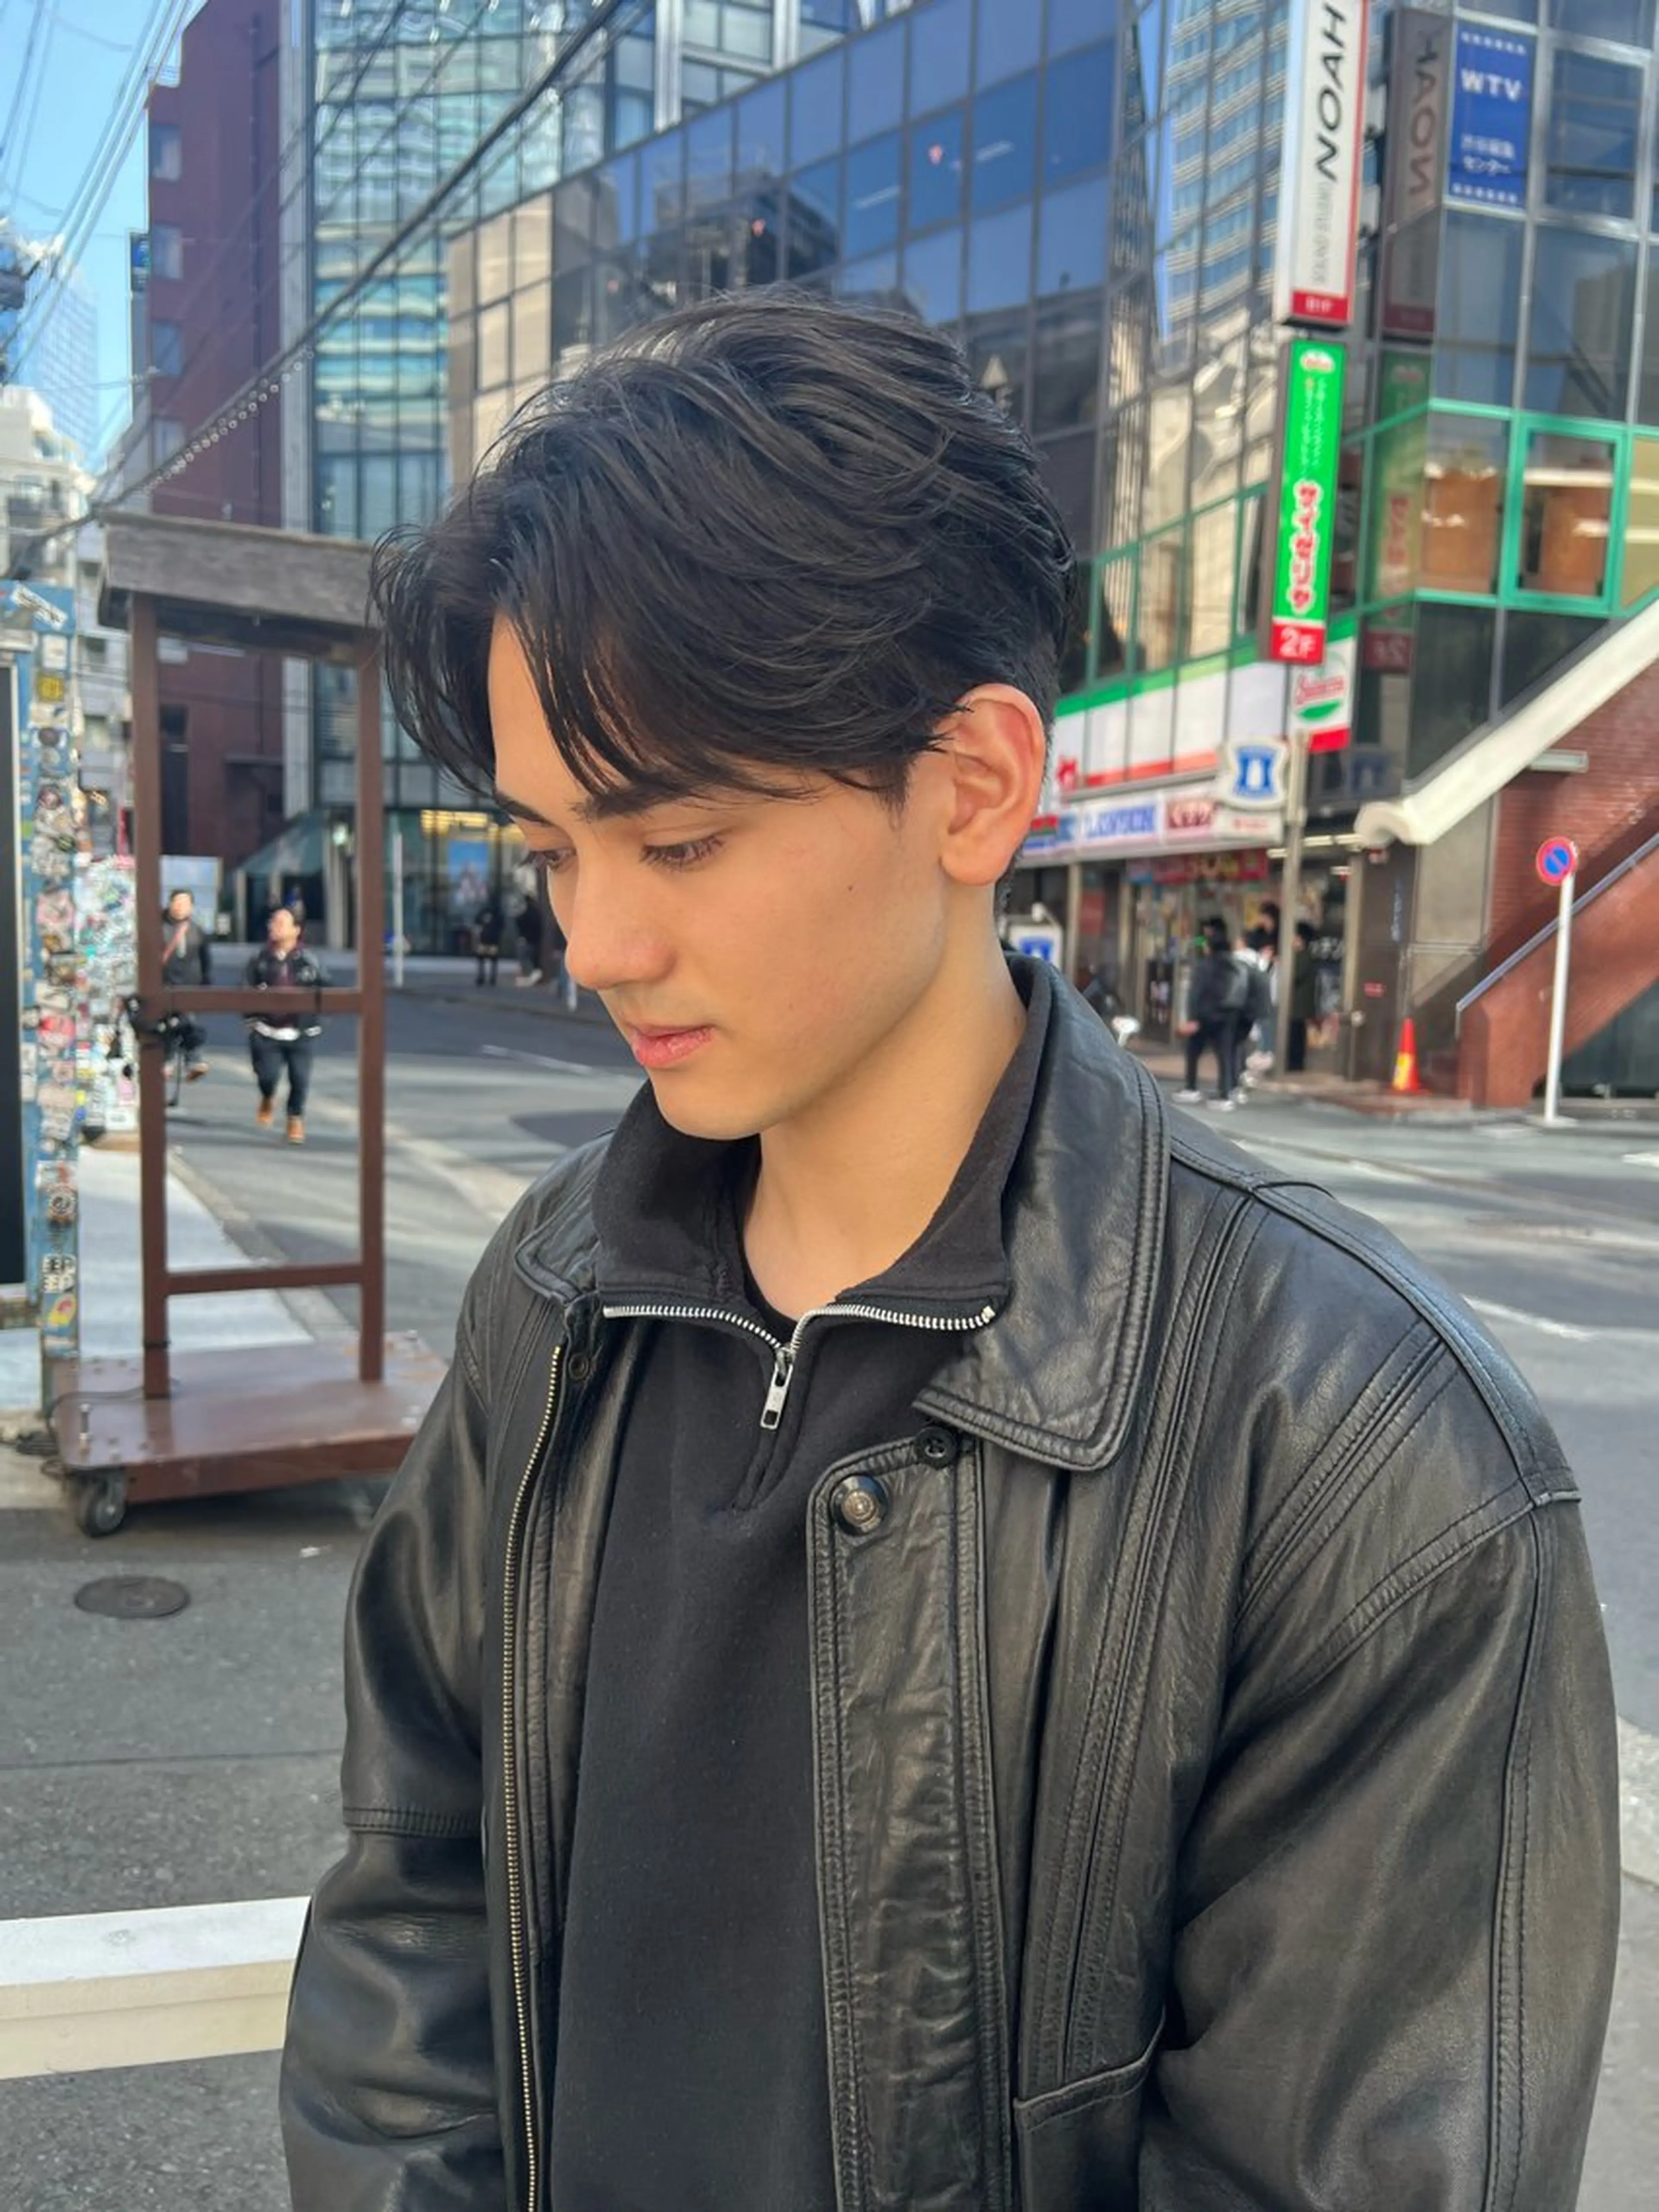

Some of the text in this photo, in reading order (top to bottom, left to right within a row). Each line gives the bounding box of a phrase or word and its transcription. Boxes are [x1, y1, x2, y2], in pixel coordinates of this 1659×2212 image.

[1315, 3, 1346, 180] NOAH
[1461, 68, 1522, 102] WTV
[1280, 627, 1316, 658] 2F
